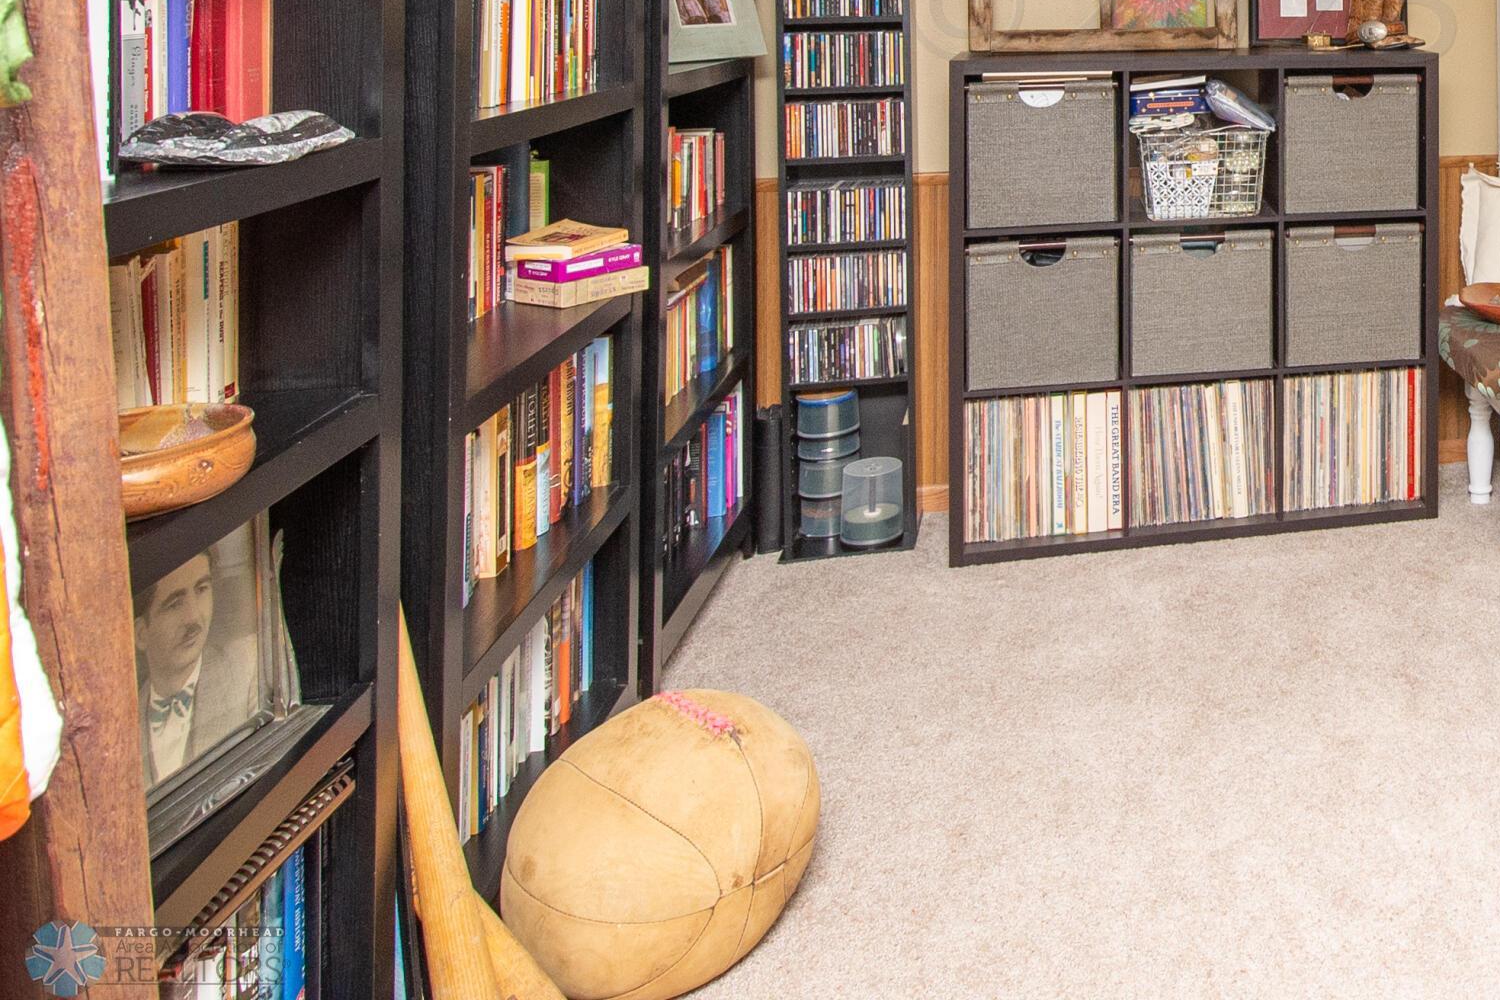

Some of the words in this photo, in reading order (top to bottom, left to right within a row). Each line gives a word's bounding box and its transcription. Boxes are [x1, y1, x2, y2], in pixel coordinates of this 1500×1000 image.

[1111, 405, 1119, 426] THE
[1111, 427, 1121, 461] GREAT
[1112, 463, 1121, 492] BAND
[1112, 494, 1121, 515] ERA
